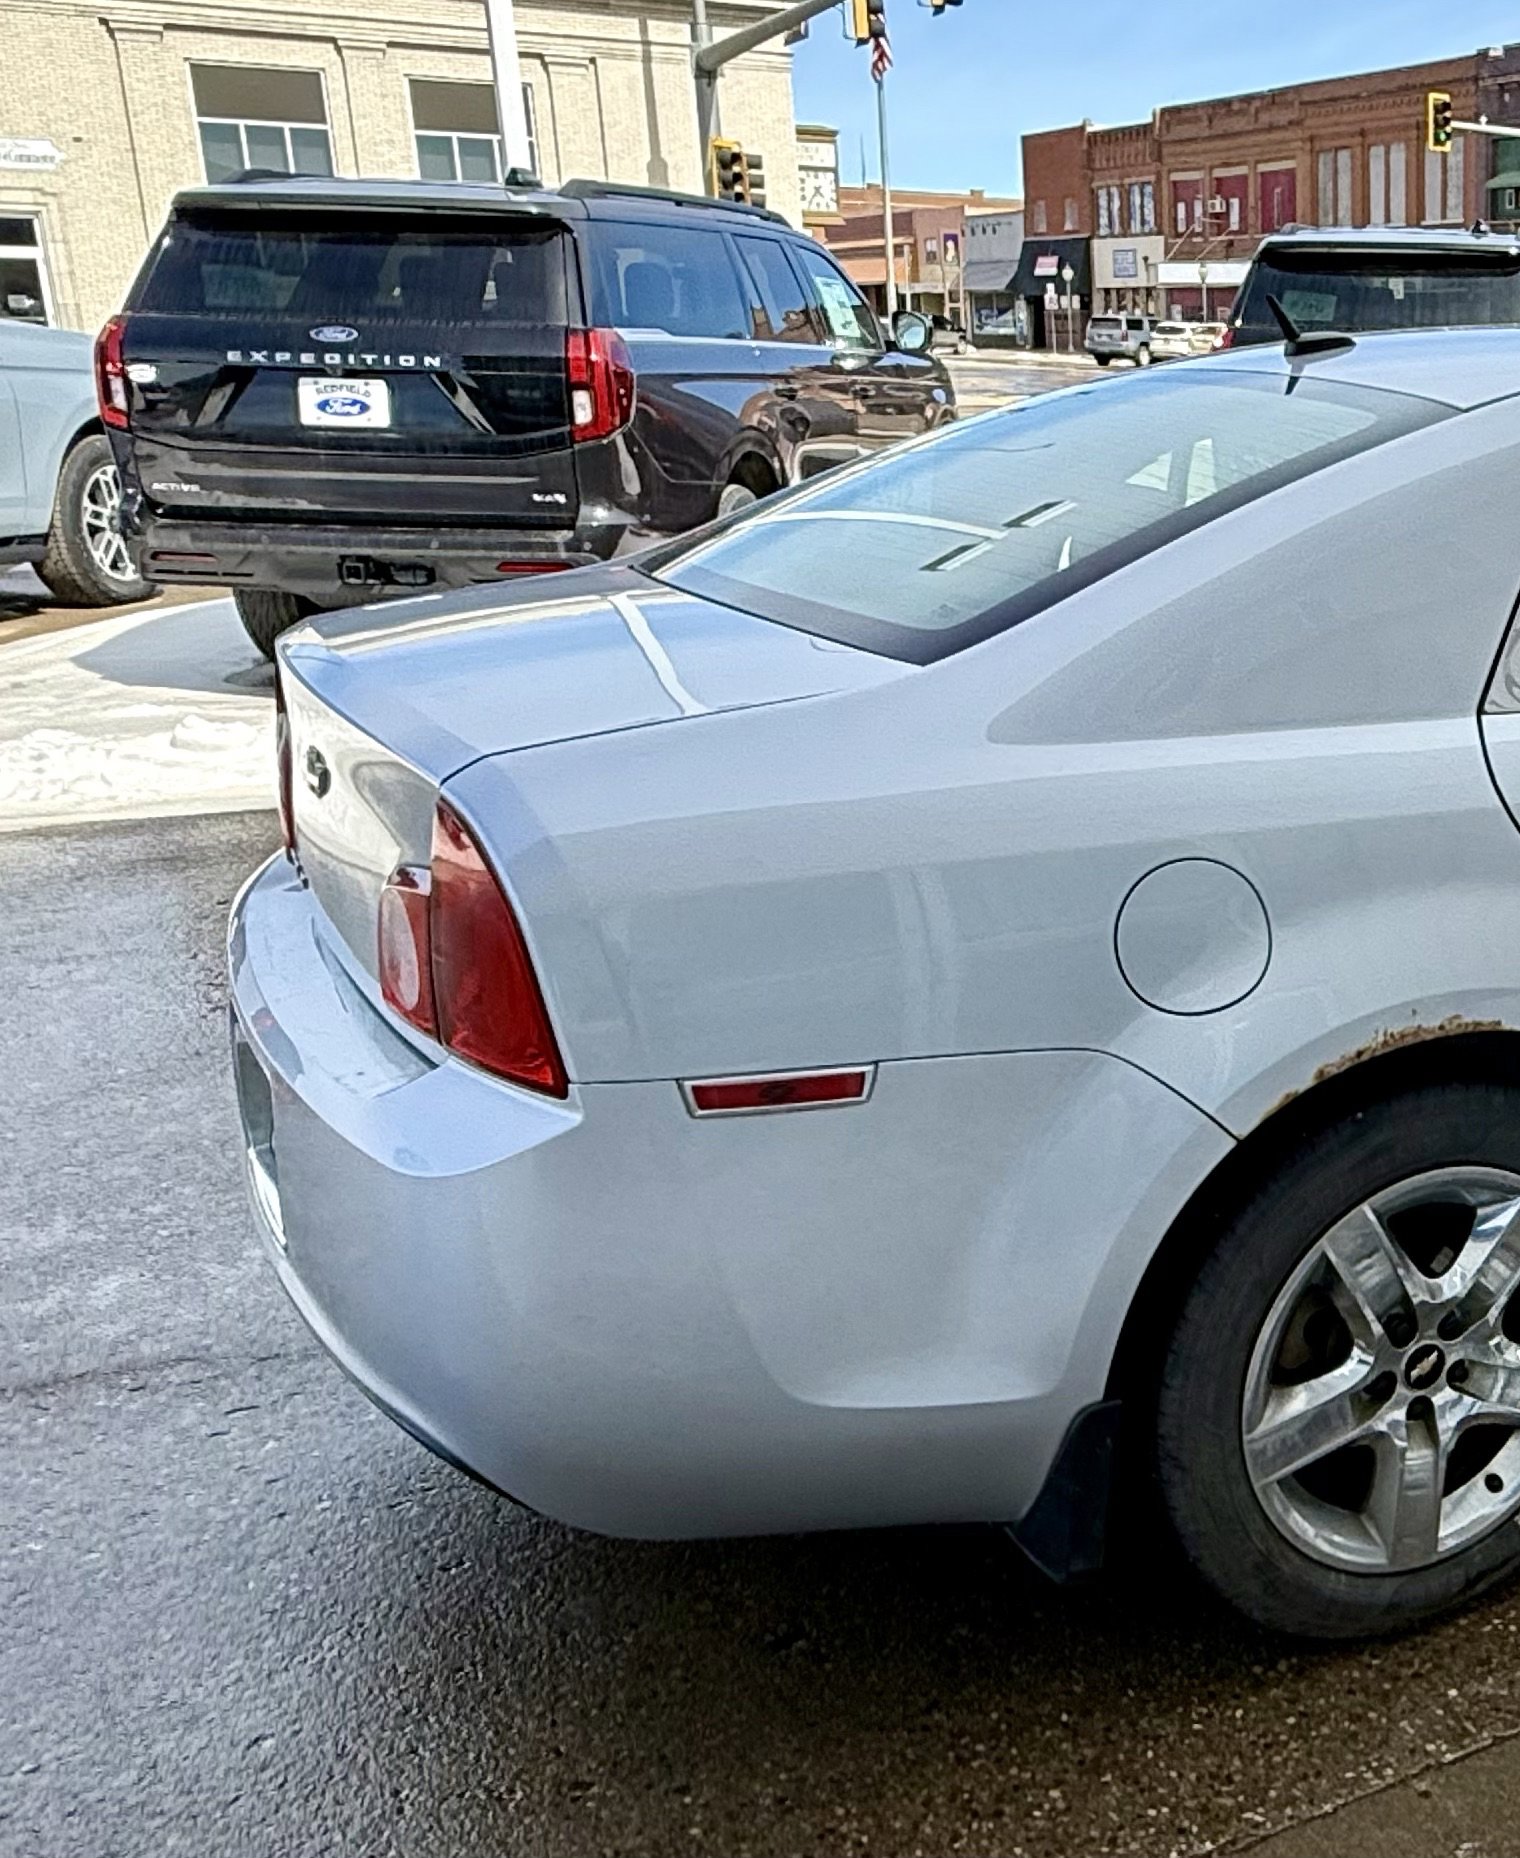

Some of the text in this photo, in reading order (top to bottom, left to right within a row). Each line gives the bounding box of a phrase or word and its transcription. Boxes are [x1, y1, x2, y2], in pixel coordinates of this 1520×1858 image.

[226, 350, 442, 368] EXPEDITION
[315, 384, 371, 398] REDFIELD
[322, 400, 364, 416] Ford
